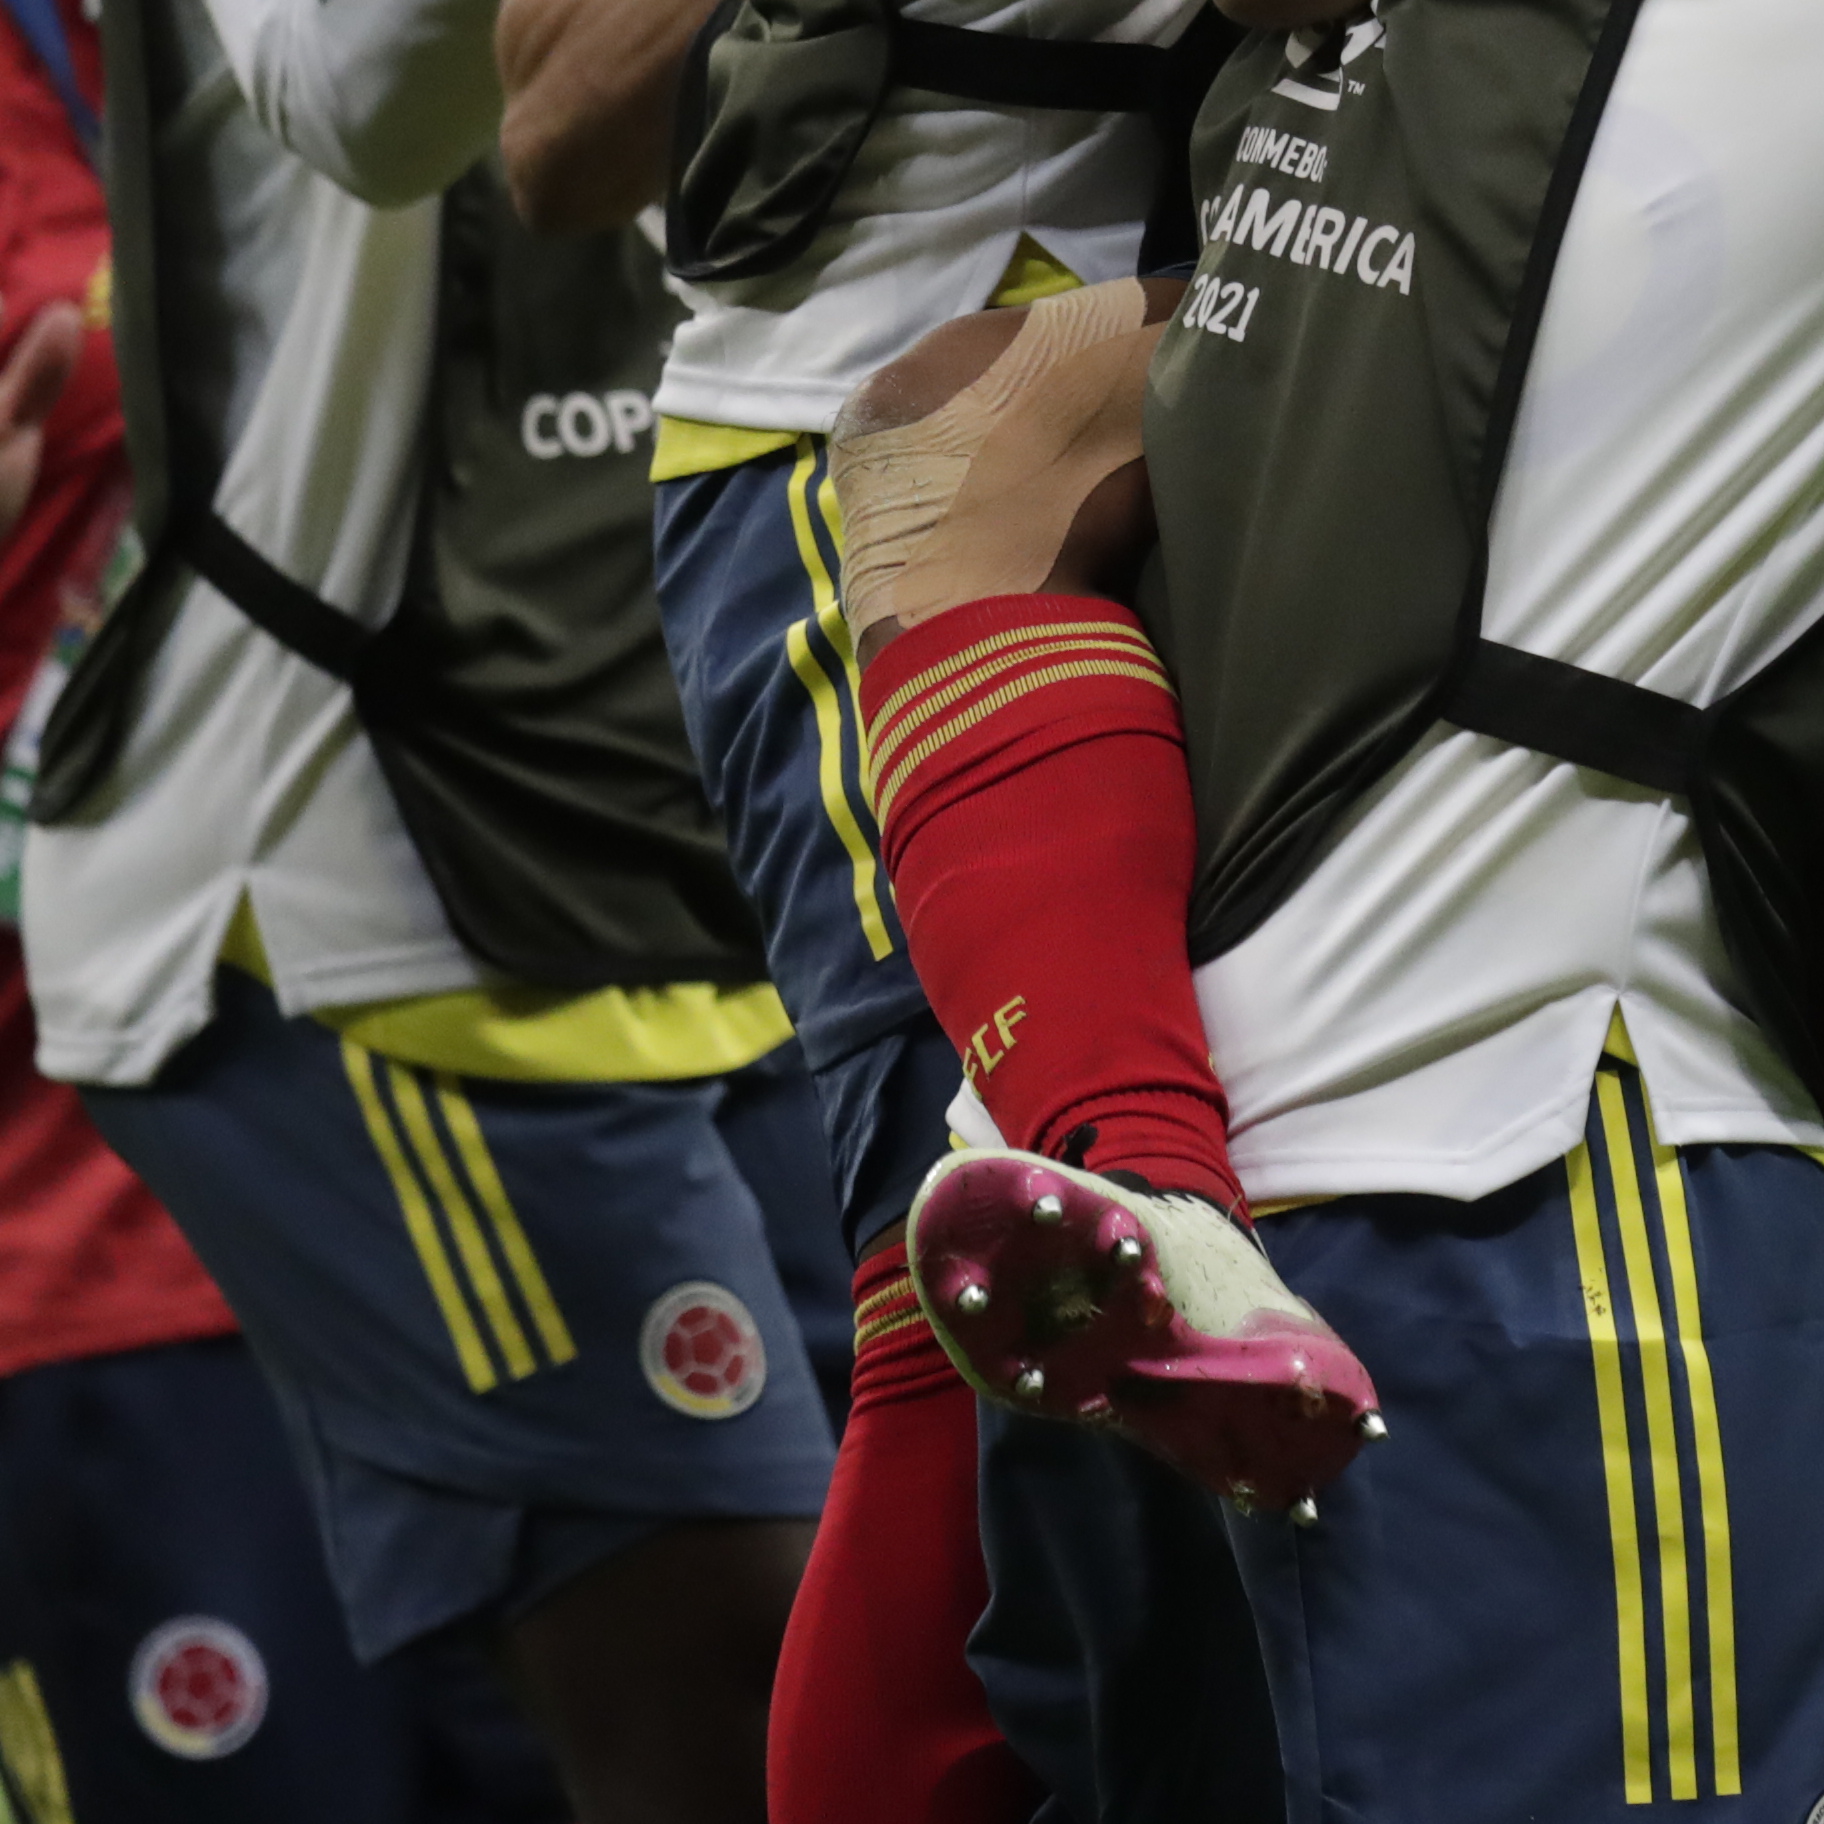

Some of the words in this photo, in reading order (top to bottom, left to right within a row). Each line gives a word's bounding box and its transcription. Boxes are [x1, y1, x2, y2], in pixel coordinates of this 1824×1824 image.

[1347, 79, 1366, 96] TM
[1236, 126, 1328, 183] CONMEBO
[1210, 183, 1416, 296] AMERICA
[1183, 272, 1260, 343] 2021
[521, 389, 655, 460] COP
[962, 995, 1027, 1102] FCF
